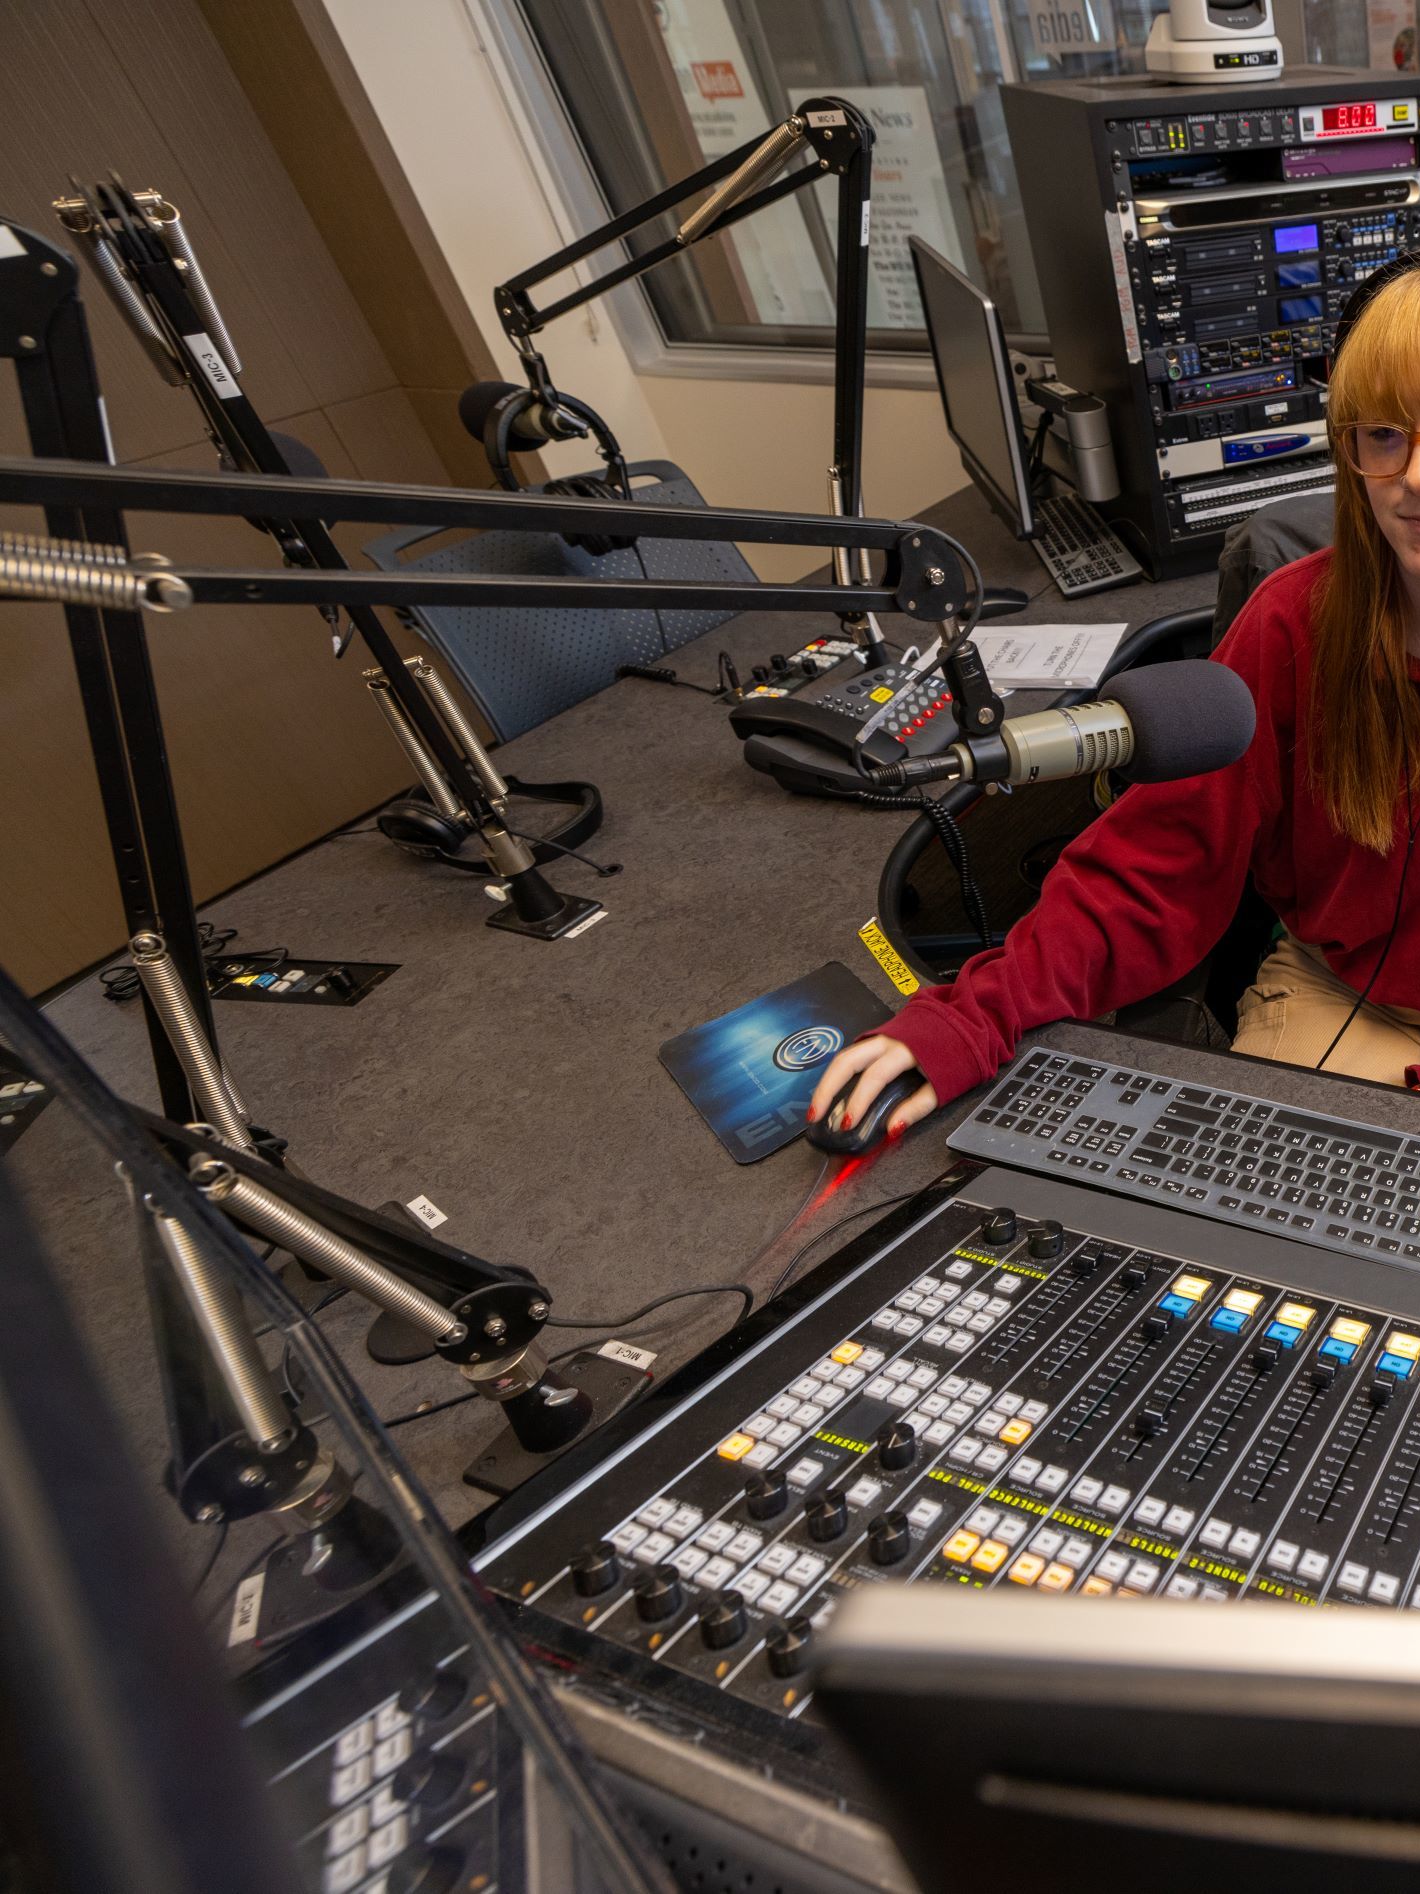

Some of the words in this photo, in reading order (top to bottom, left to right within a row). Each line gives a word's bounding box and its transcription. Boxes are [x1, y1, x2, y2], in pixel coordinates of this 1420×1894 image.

[1243, 54, 1260, 66] HD
[817, 114, 836, 123] MIC-2
[1338, 104, 1375, 128] 8.00
[1146, 237, 1170, 247] TASCAM
[1152, 274, 1176, 284] TASCAM
[1157, 311, 1181, 320] TASCAM
[202, 353, 228, 383] MIC-3
[874, 945, 909, 981] HEADPHONE
[420, 1204, 437, 1220] MIC-4
[615, 1346, 642, 1361] MIC-1
[815, 1449, 840, 1460] EVENT
[1010, 1484, 1044, 1498] SOURCE
[1072, 1504, 1107, 1519] SOURCE
[1137, 1526, 1171, 1541] SOURCE
[1201, 1550, 1237, 1564] SOURCE
[1271, 1572, 1308, 1587] SOURCE
